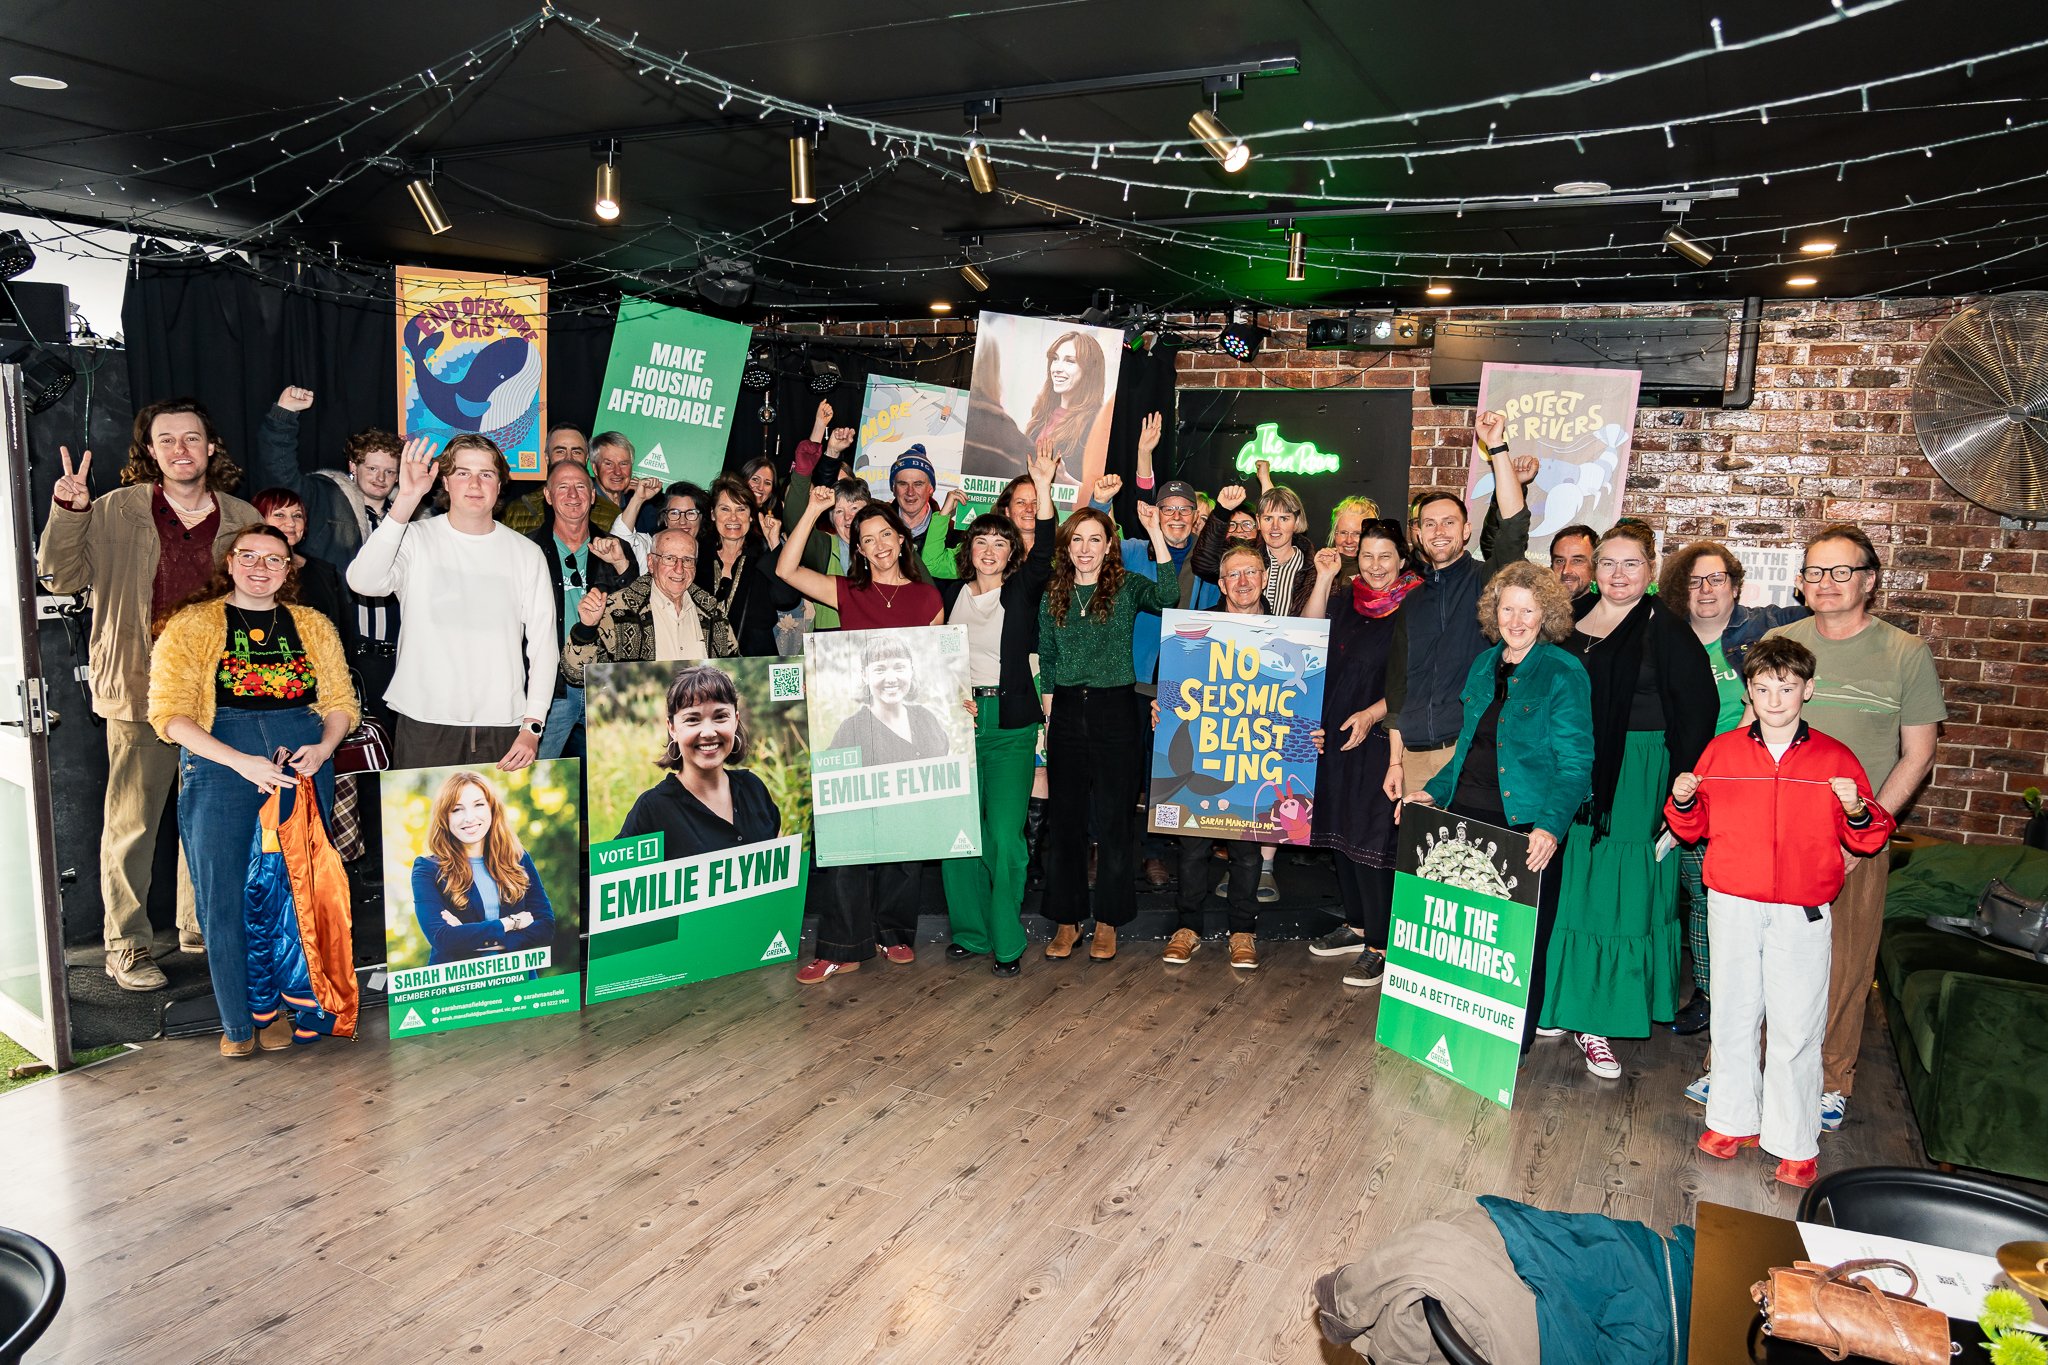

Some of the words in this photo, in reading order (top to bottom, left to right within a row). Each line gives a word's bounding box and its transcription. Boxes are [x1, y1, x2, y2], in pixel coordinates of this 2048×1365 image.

[415, 301, 459, 337] END
[461, 297, 539, 343] OFFSHORE
[450, 317, 495, 339] GAS
[649, 341, 707, 373] MAKE
[630, 365, 713, 401] HOUSING
[607, 388, 726, 429] AFFORDABLE
[861, 402, 913, 448] MORE
[1255, 424, 1285, 454] The
[643, 458, 666, 470] GREENS
[651, 452, 662, 461] THE
[1295, 444, 1340, 473] Room
[963, 478, 996, 493] SARAH
[1058, 487, 1075, 500] MP
[967, 494, 987, 503] EMBER
[1763, 552, 1789, 566] THE
[1768, 567, 1787, 581] TO
[1208, 639, 1261, 682] NO
[1174, 678, 1297, 721] SEISMIC
[1198, 716, 1291, 753] BLAST
[815, 755, 841, 767] VOTE
[1202, 751, 1283, 785] -ING
[818, 771, 891, 807] EMILIE
[896, 761, 961, 796] FLYNN
[1200, 816, 1224, 826] SARAH
[1225, 817, 1263, 829] MANSFIELD
[598, 846, 635, 865] VOTE
[600, 864, 699, 922] EMILIE
[708, 844, 791, 898] FLYNN
[1423, 894, 1459, 932] TAX
[1463, 905, 1499, 945] THE
[766, 946, 787, 957] GREENS
[773, 940, 783, 949] THE
[394, 968, 440, 990] SARAH
[445, 955, 520, 982] MANSFIELD
[525, 950, 546, 968] MP
[394, 990, 430, 1004] MEMBER
[431, 987, 447, 997] FOR
[448, 981, 486, 994] WESTERN
[487, 974, 525, 987] VICTORIA
[1389, 974, 1418, 994] BUILD
[1419, 986, 1427, 998] A
[1429, 988, 1469, 1014] BETTER
[1472, 1003, 1516, 1030] FUTURE
[1430, 1051, 1450, 1067] GREENS
[1436, 1045, 1446, 1056] THE
